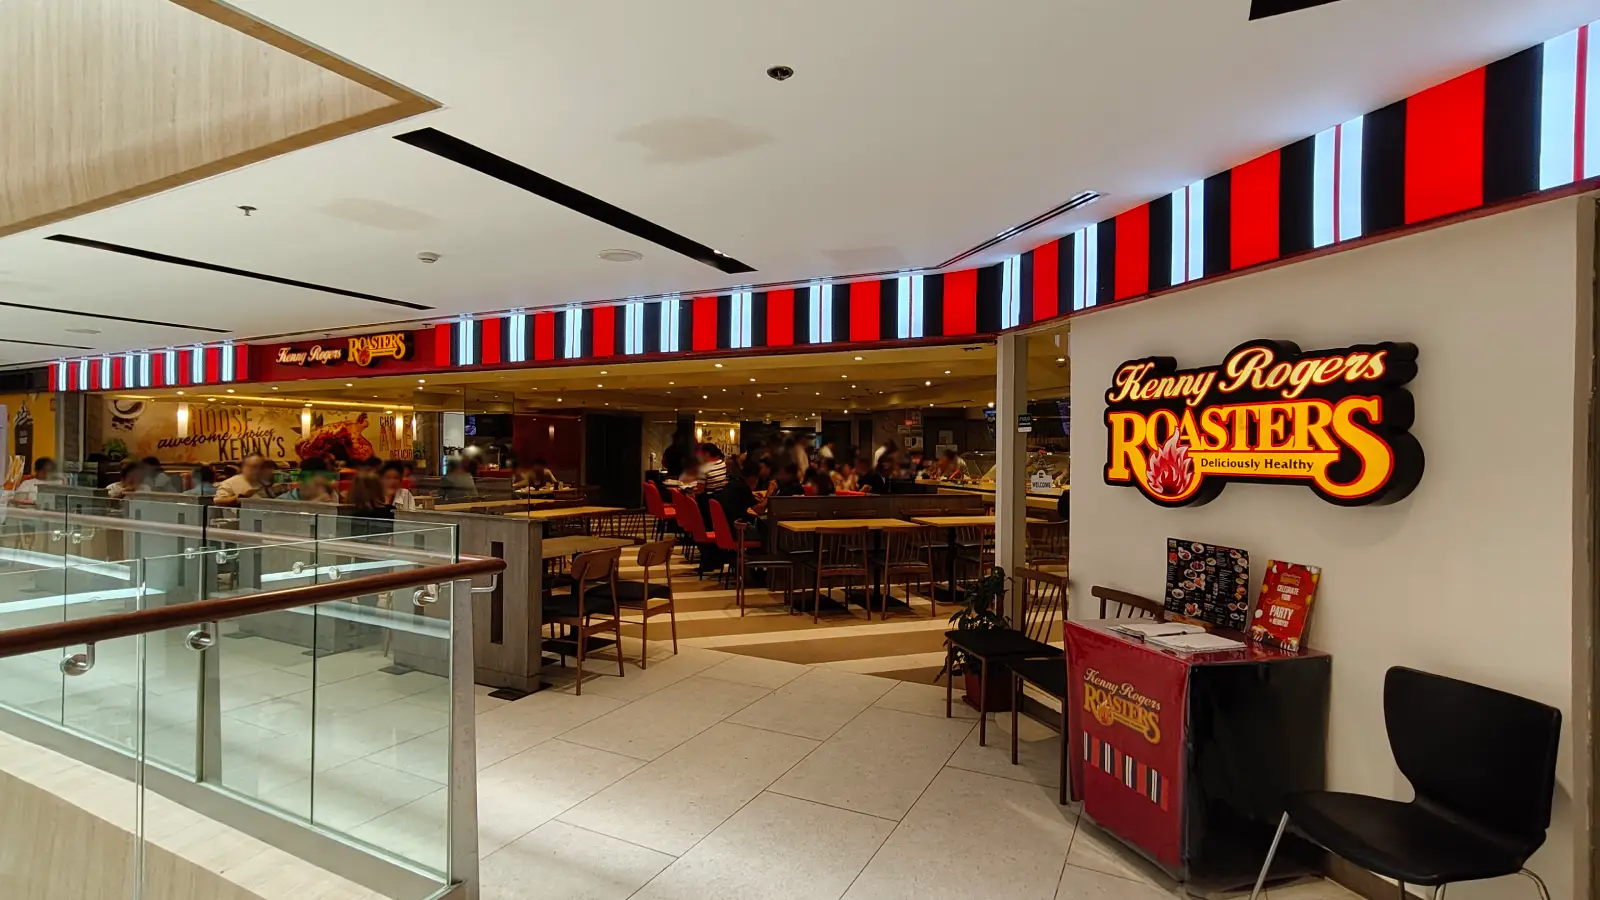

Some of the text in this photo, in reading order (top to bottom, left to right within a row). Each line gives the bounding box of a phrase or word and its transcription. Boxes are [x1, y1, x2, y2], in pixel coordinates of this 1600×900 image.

[276, 333, 405, 366] Kenny Rogers ROASTERS
[1109, 347, 1388, 406] Kenny Rogers
[157, 427, 276, 449] awesome choices
[218, 436, 286, 461] KENNY'S
[1108, 395, 1394, 500] ROASTERS
[1201, 458, 1314, 471] Deliciously Healthy
[1269, 605, 1294, 620] PARTY
[1083, 668, 1161, 711] Kenny Rogers
[1084, 683, 1161, 744] ROASTERS
